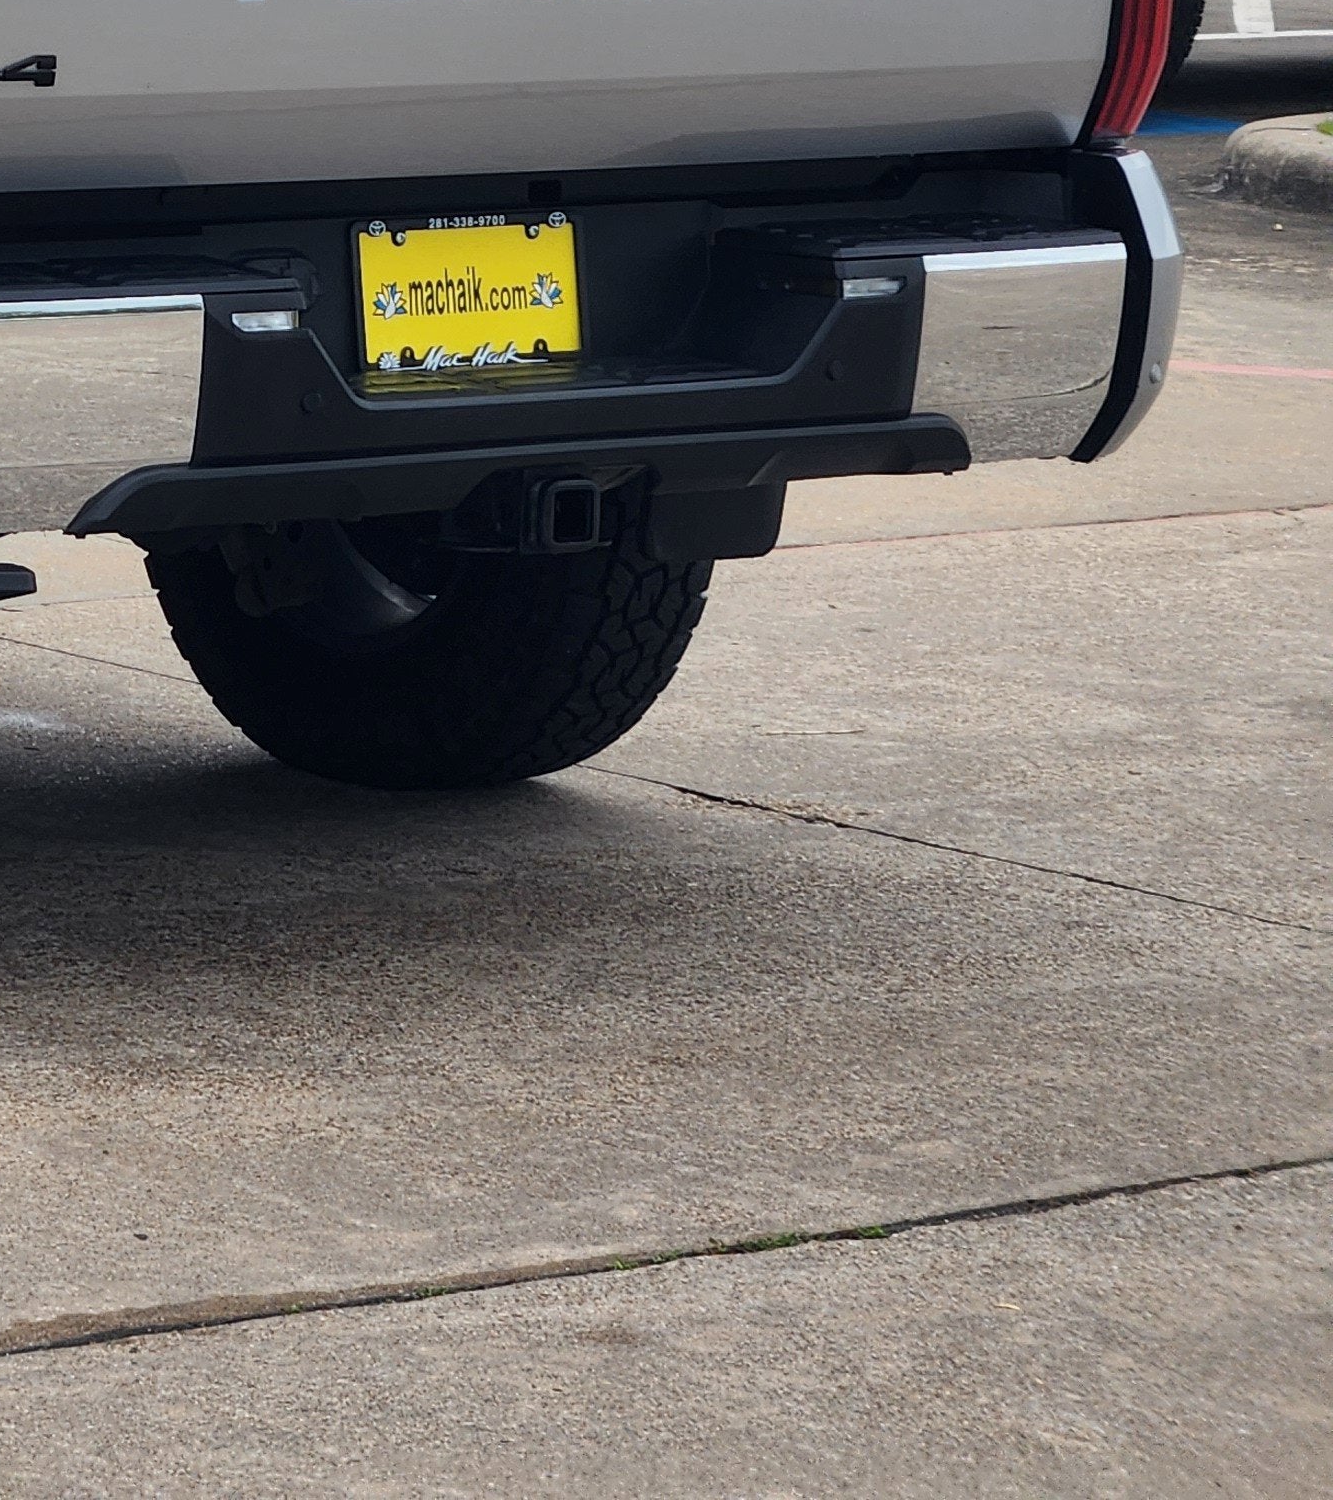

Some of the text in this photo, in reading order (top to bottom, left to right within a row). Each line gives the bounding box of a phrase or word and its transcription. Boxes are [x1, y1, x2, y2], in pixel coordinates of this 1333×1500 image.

[428, 214, 506, 229] 281-338-9700
[408, 266, 528, 316] machaik.com
[422, 345, 471, 371] Mac
